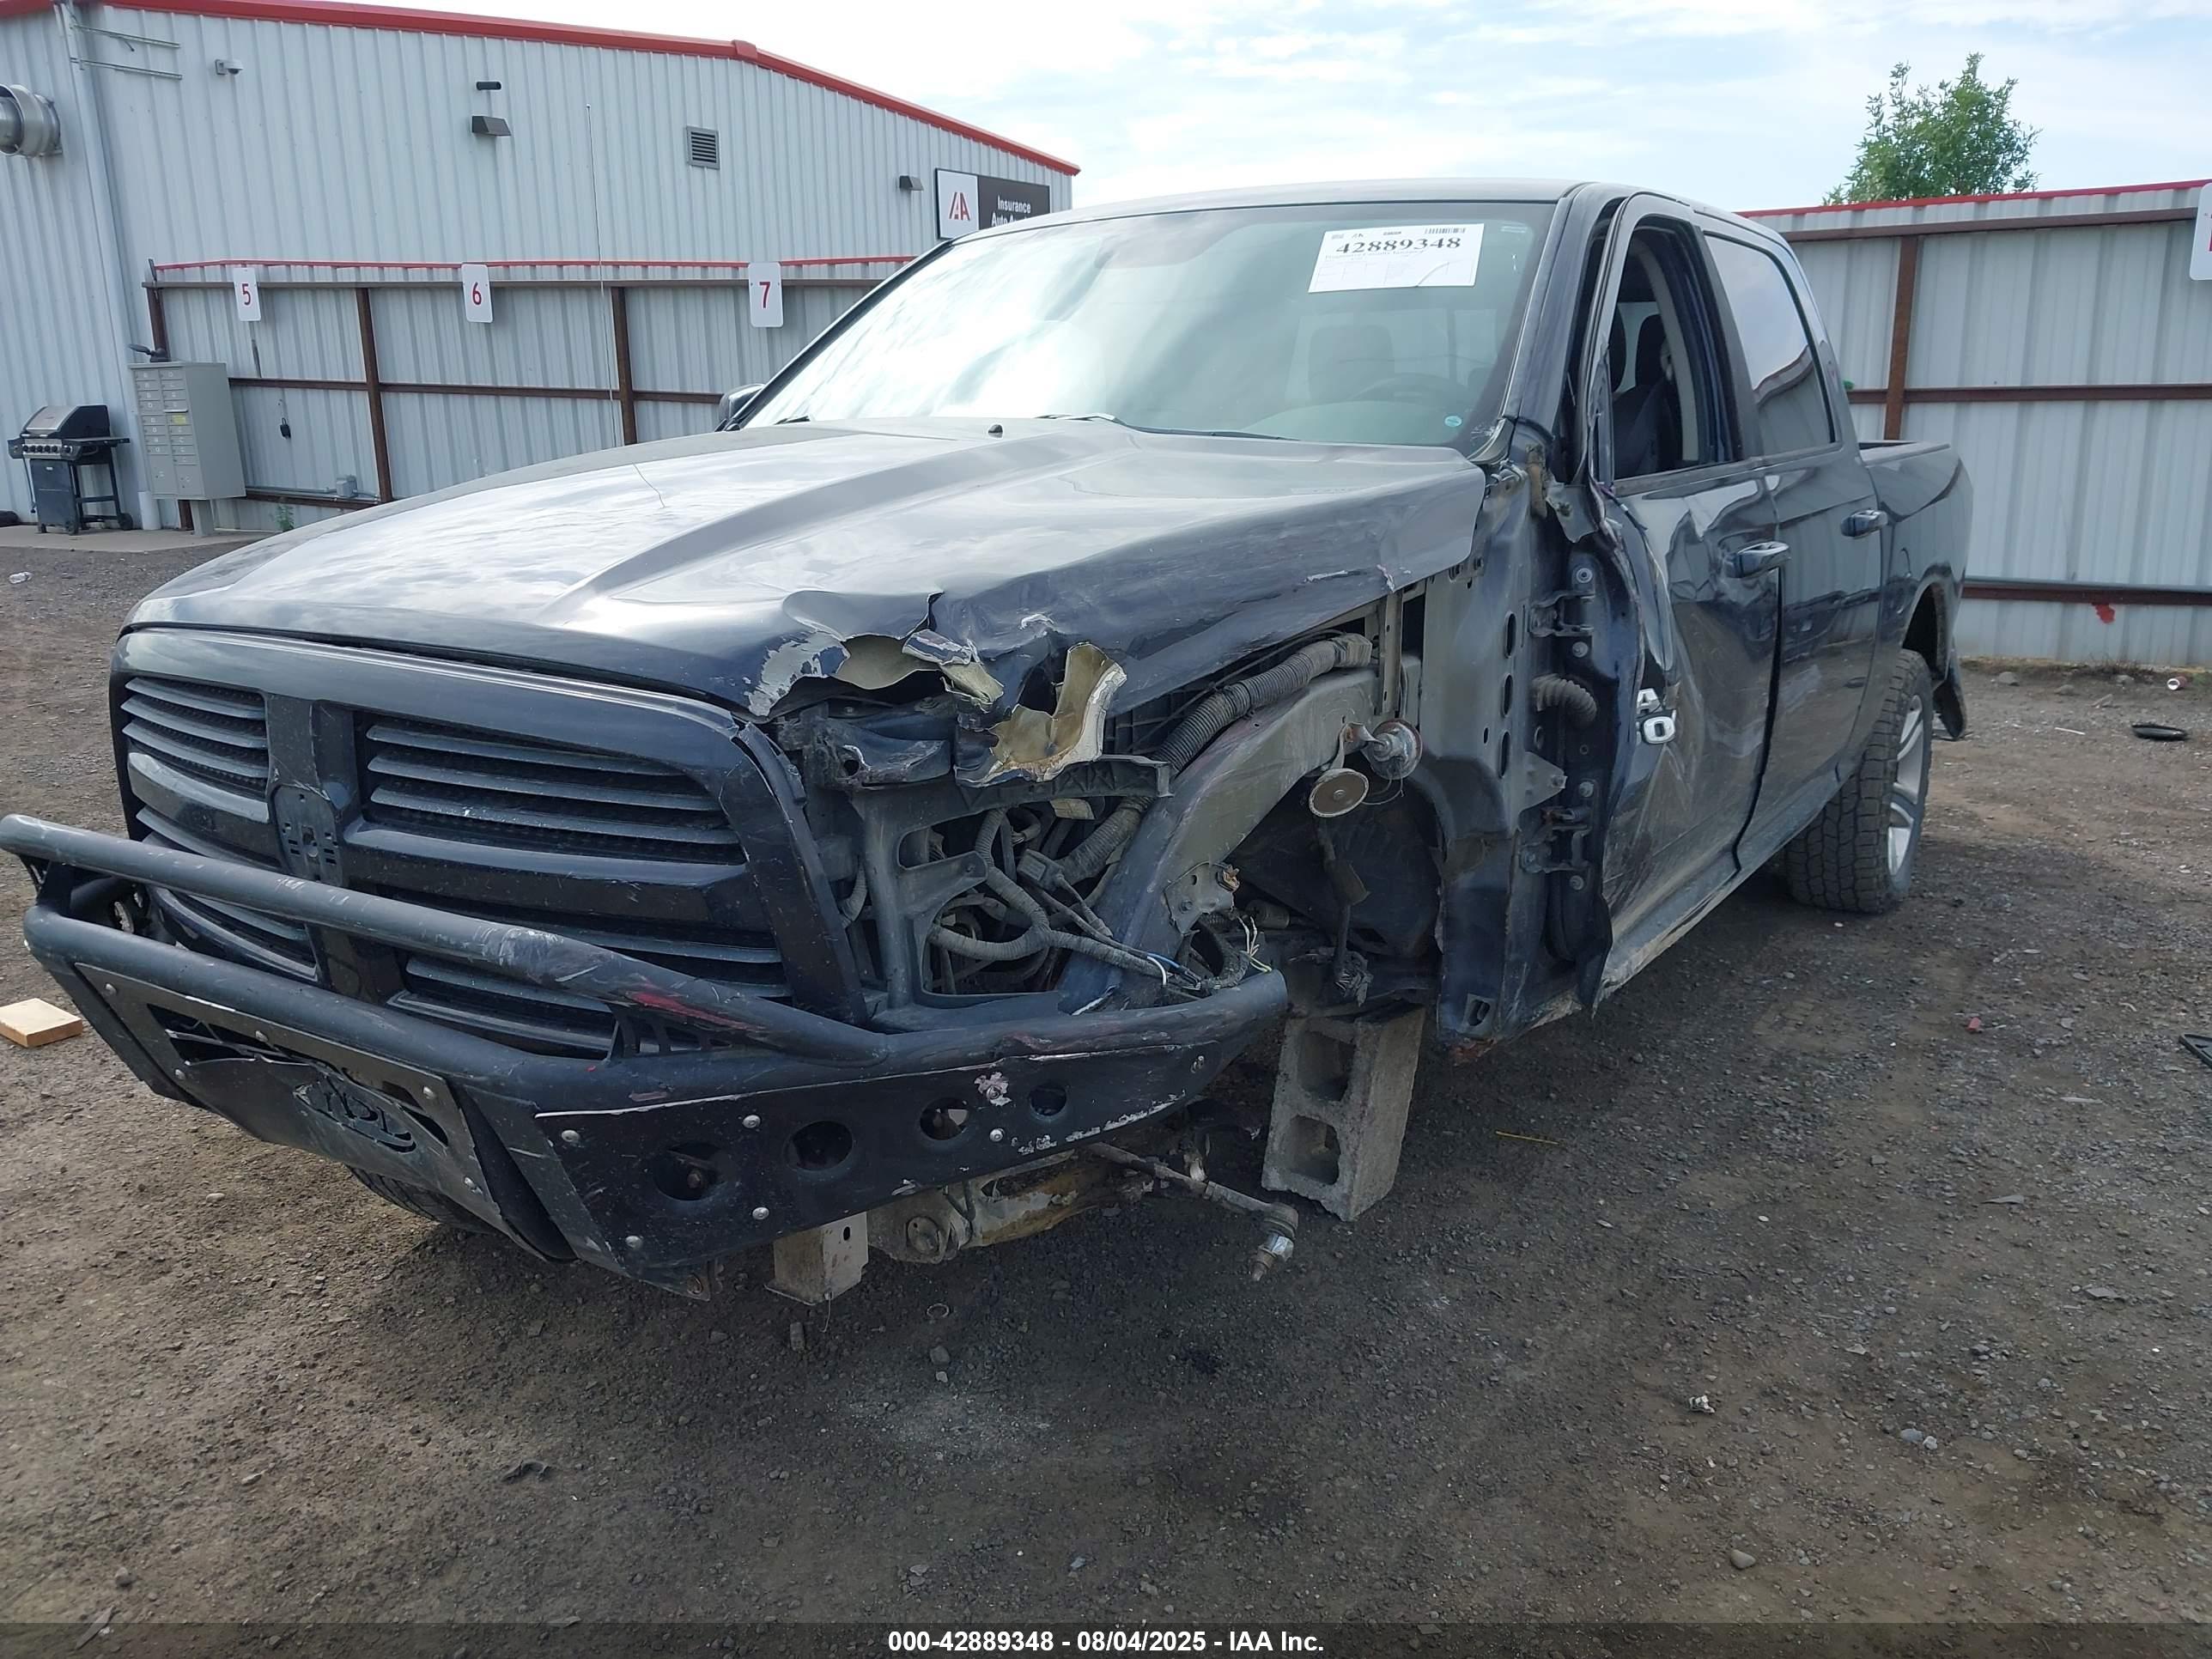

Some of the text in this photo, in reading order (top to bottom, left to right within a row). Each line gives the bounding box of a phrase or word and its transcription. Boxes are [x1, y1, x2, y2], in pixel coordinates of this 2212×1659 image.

[997, 195, 1031, 214] Insurance
[1336, 237, 1462, 253] 42889348
[241, 283, 252, 306] 5
[472, 282, 483, 306] 6
[759, 281, 771, 309] 7
